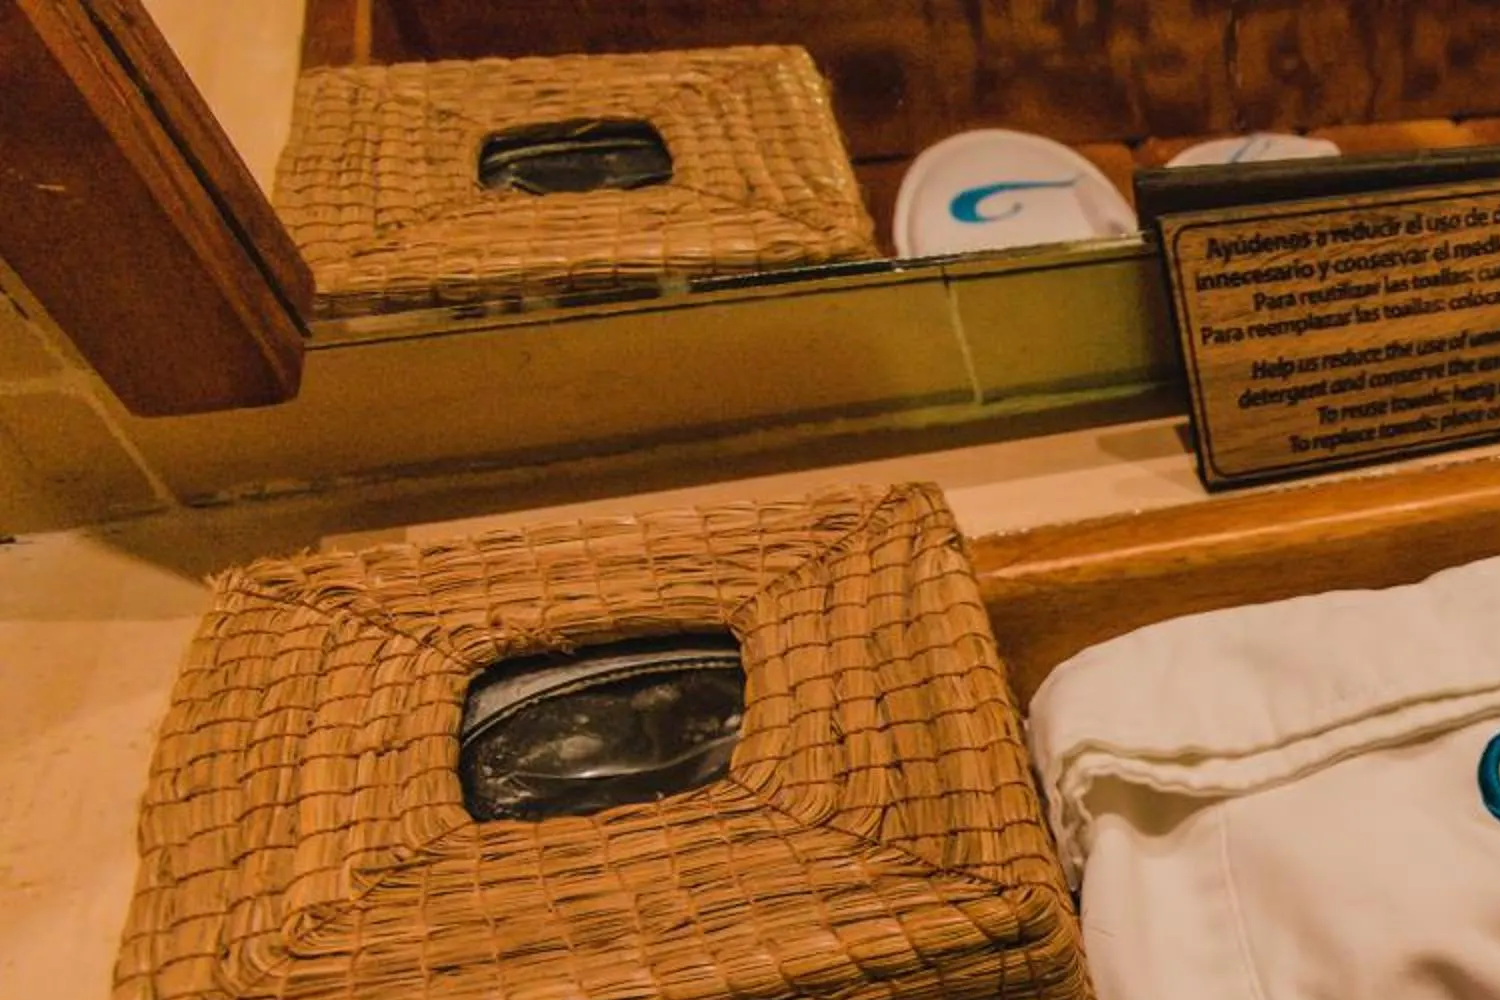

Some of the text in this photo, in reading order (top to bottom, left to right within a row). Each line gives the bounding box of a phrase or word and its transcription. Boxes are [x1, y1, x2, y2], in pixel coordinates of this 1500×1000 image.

[1315, 231, 1328, 246] a
[1331, 216, 1401, 243] reducir
[1405, 212, 1423, 235] el
[1426, 214, 1461, 232] uso
[1464, 206, 1489, 227] de
[1195, 258, 1314, 292] innecesario
[1317, 259, 1329, 281] y
[1334, 247, 1428, 274] conservar
[1433, 240, 1449, 261] el
[1253, 291, 1297, 312] Para
[1301, 280, 1380, 304] reutilizar
[1384, 273, 1408, 295] las
[1201, 325, 1244, 346] Para
[1248, 312, 1352, 340] reemplazar
[1354, 304, 1380, 324] las
[1251, 355, 1295, 382] Help
[1297, 357, 1320, 373] us
[1322, 347, 1384, 369] reduce
[1385, 340, 1413, 359] the
[1417, 338, 1447, 356] use
[1449, 328, 1468, 348] of
[1238, 379, 1328, 409] detergent
[1329, 369, 1366, 394] and
[1369, 361, 1448, 388] conserve
[1449, 355, 1477, 376] the
[1316, 405, 1339, 425] To
[1341, 400, 1388, 420] reuse
[1453, 382, 1496, 404] hang
[1289, 434, 1311, 453] To
[1312, 427, 1377, 453] replace
[1440, 407, 1487, 433] place
